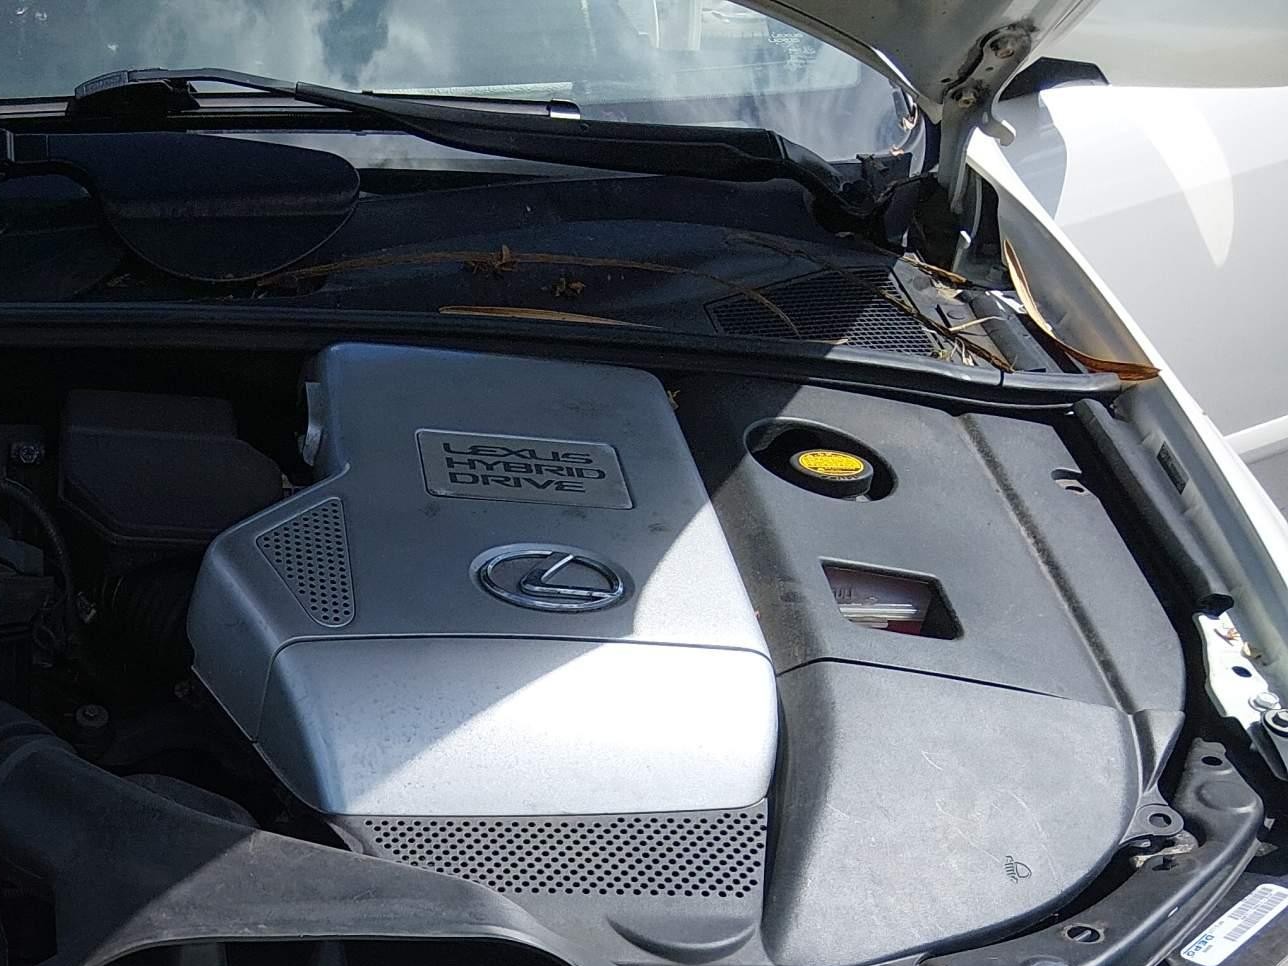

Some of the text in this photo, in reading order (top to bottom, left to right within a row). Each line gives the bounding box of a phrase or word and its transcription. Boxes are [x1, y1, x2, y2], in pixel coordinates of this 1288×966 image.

[443, 443, 593, 464] LEXUS
[445, 457, 606, 480] HYBRID
[449, 471, 586, 493] DRIVE
[1186, 934, 1215, 957] DEPO
